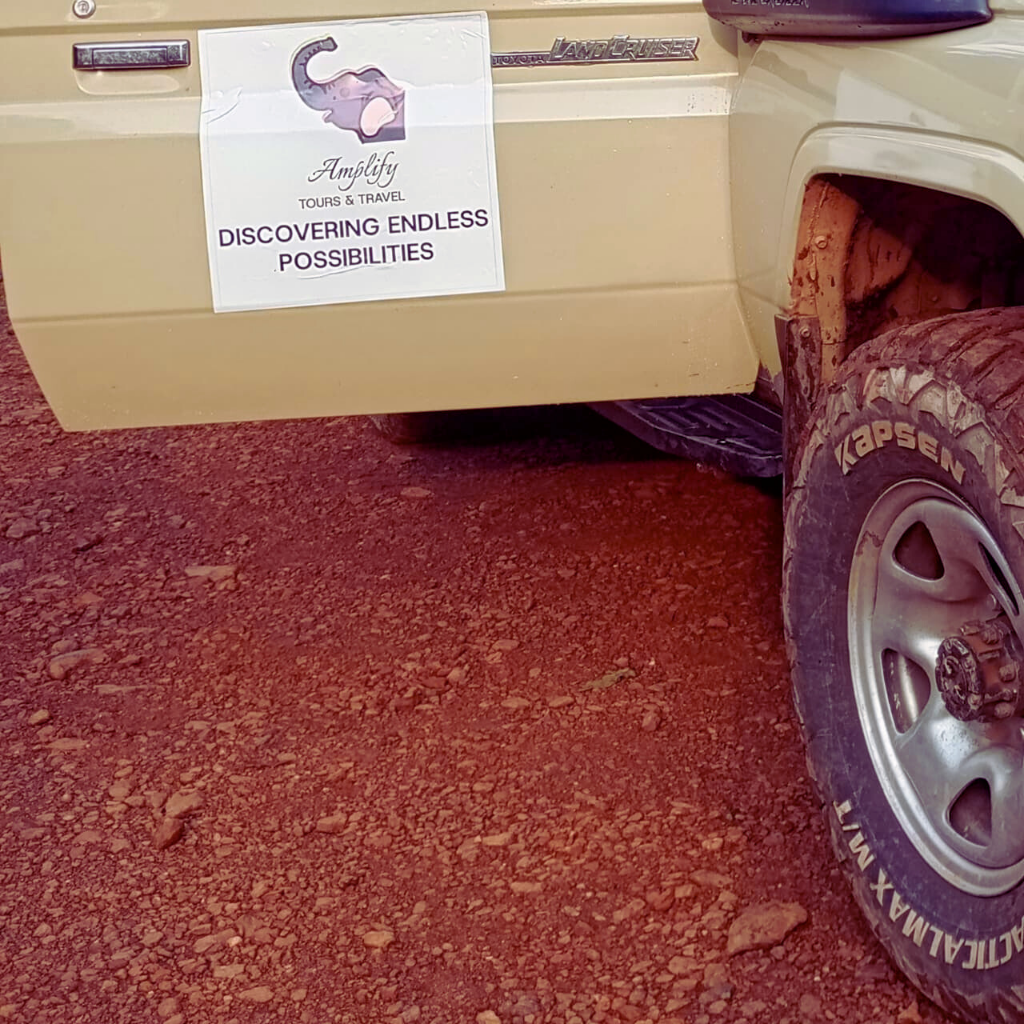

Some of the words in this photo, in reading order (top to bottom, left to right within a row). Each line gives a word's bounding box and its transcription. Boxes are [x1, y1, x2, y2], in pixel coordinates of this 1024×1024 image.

[611, 35, 700, 60] CRUISER
[308, 151, 399, 191] Amplify
[298, 195, 341, 209] TOURS
[345, 195, 355, 206] &
[358, 191, 405, 205] TRAVEL
[218, 217, 380, 247] DISCOVERING
[388, 209, 489, 235] ENDLESS
[278, 241, 434, 272] POSSIBILITIES
